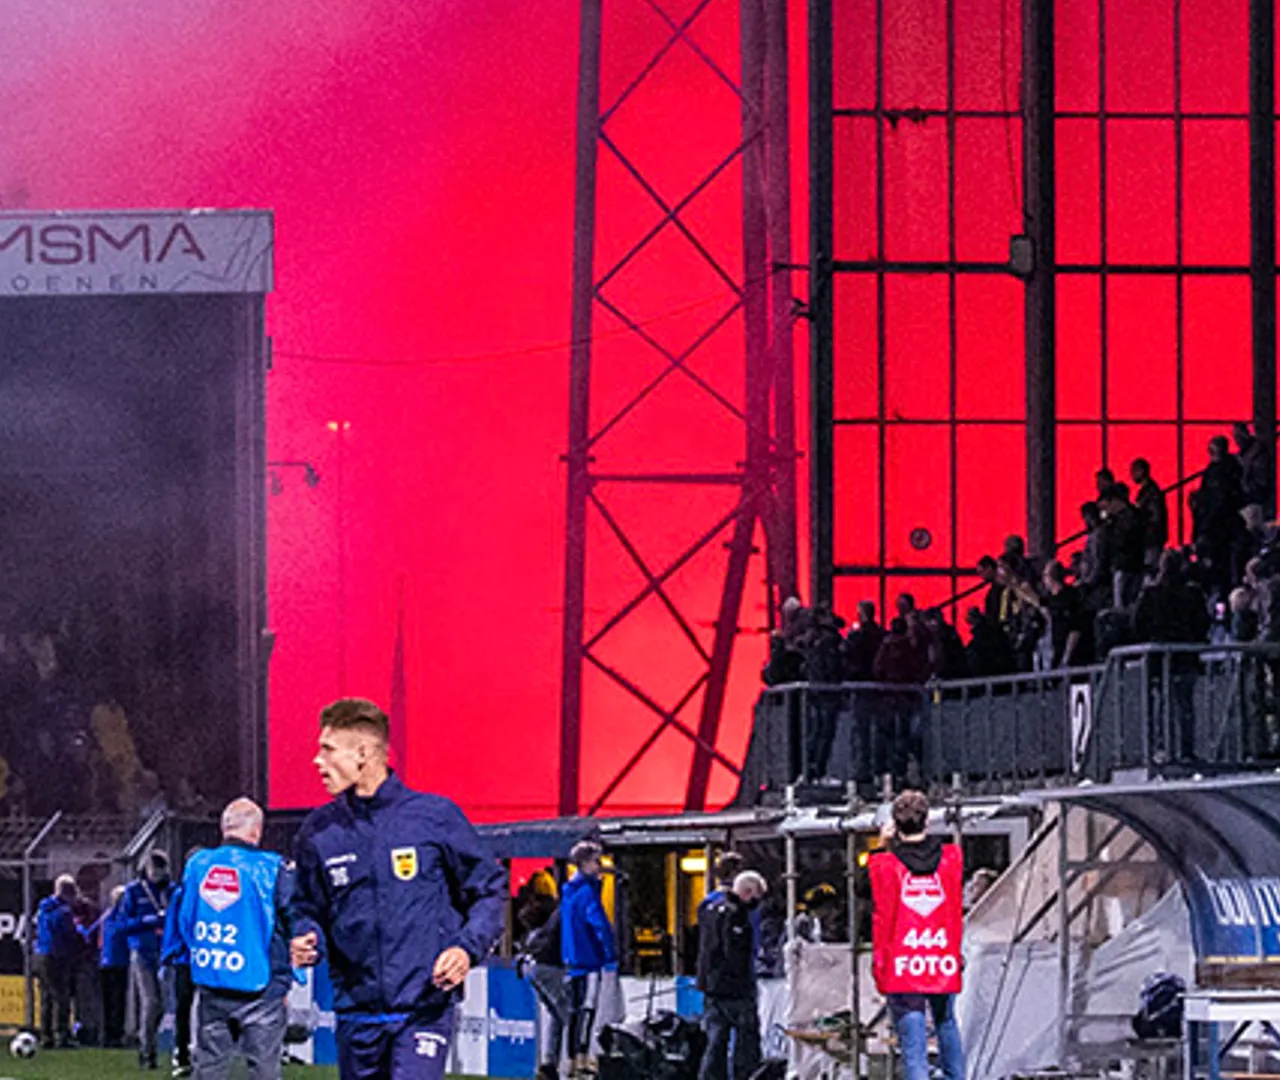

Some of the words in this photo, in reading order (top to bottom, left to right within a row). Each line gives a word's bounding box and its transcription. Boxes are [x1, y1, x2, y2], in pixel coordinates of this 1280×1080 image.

[195, 921, 238, 945] 032
[903, 928, 948, 949] 444
[895, 955, 958, 977] FOTO
